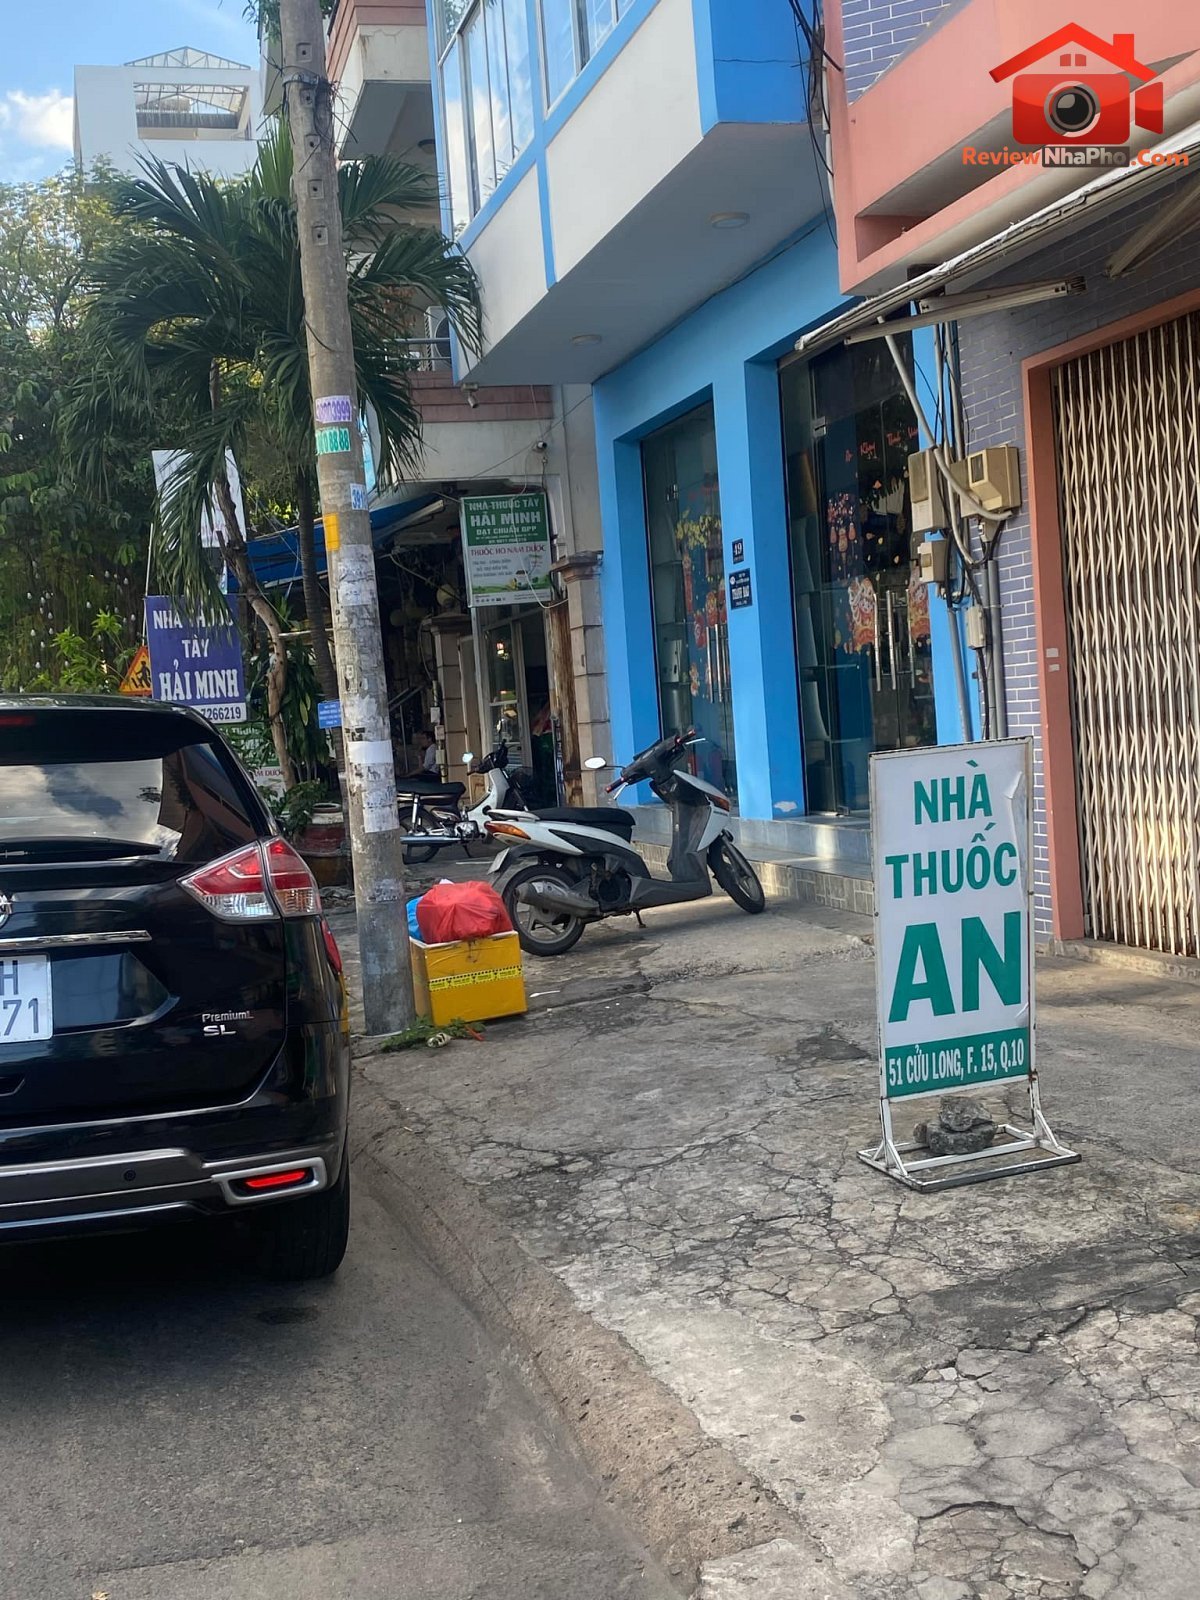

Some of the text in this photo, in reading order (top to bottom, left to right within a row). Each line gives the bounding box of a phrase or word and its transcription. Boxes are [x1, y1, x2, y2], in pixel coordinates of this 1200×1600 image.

[470, 510, 541, 527] HẢI MINH
[159, 659, 239, 701] HẢI MINH
[914, 759, 993, 825] NHÀ
[885, 822, 1017, 899] THUỐC
[888, 910, 1022, 1023] AN
[202, 1010, 247, 1022] Premium
[203, 1025, 237, 1036] SL
[889, 1038, 1025, 1086] 51 CỬU LONG, F. 15, Q.10
